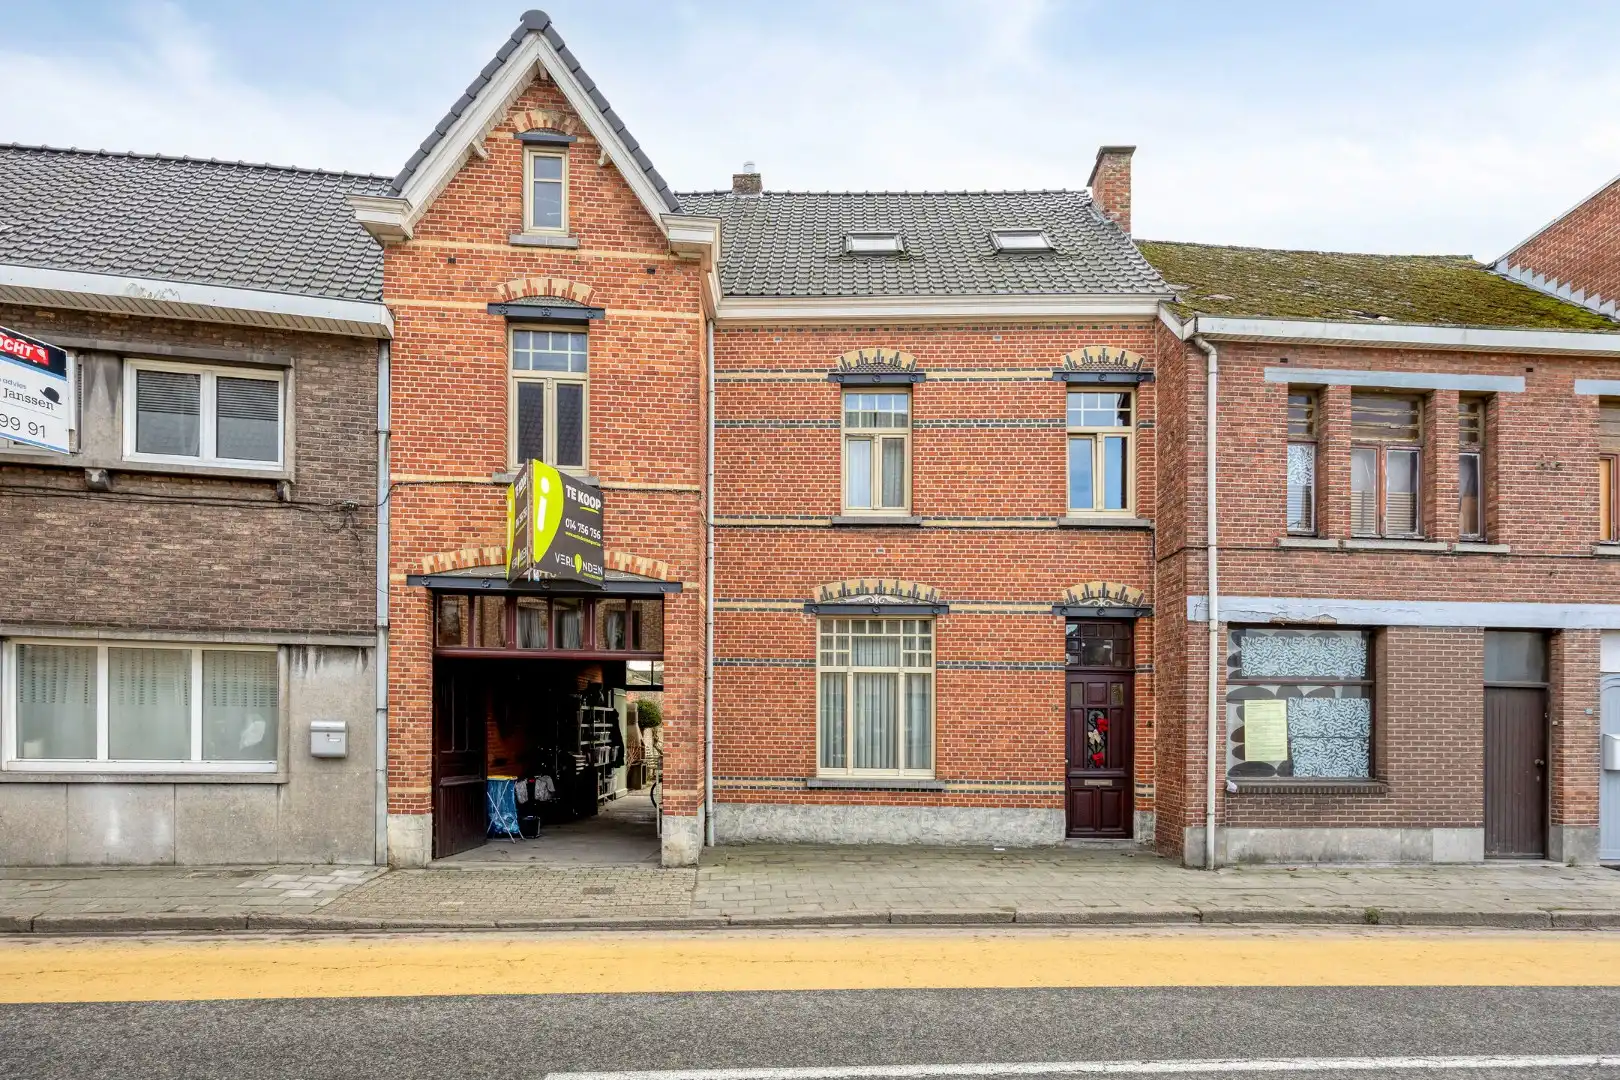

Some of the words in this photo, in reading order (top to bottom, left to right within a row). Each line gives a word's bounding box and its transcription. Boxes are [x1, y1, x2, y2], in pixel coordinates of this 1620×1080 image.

[3, 387, 54, 411] Janssen
[28, 421, 46, 438] 91
[565, 484, 577, 501] TE
[577, 491, 602, 510] KOOP
[565, 517, 577, 531] 014
[577, 522, 589, 536] 756
[589, 527, 601, 540] 756
